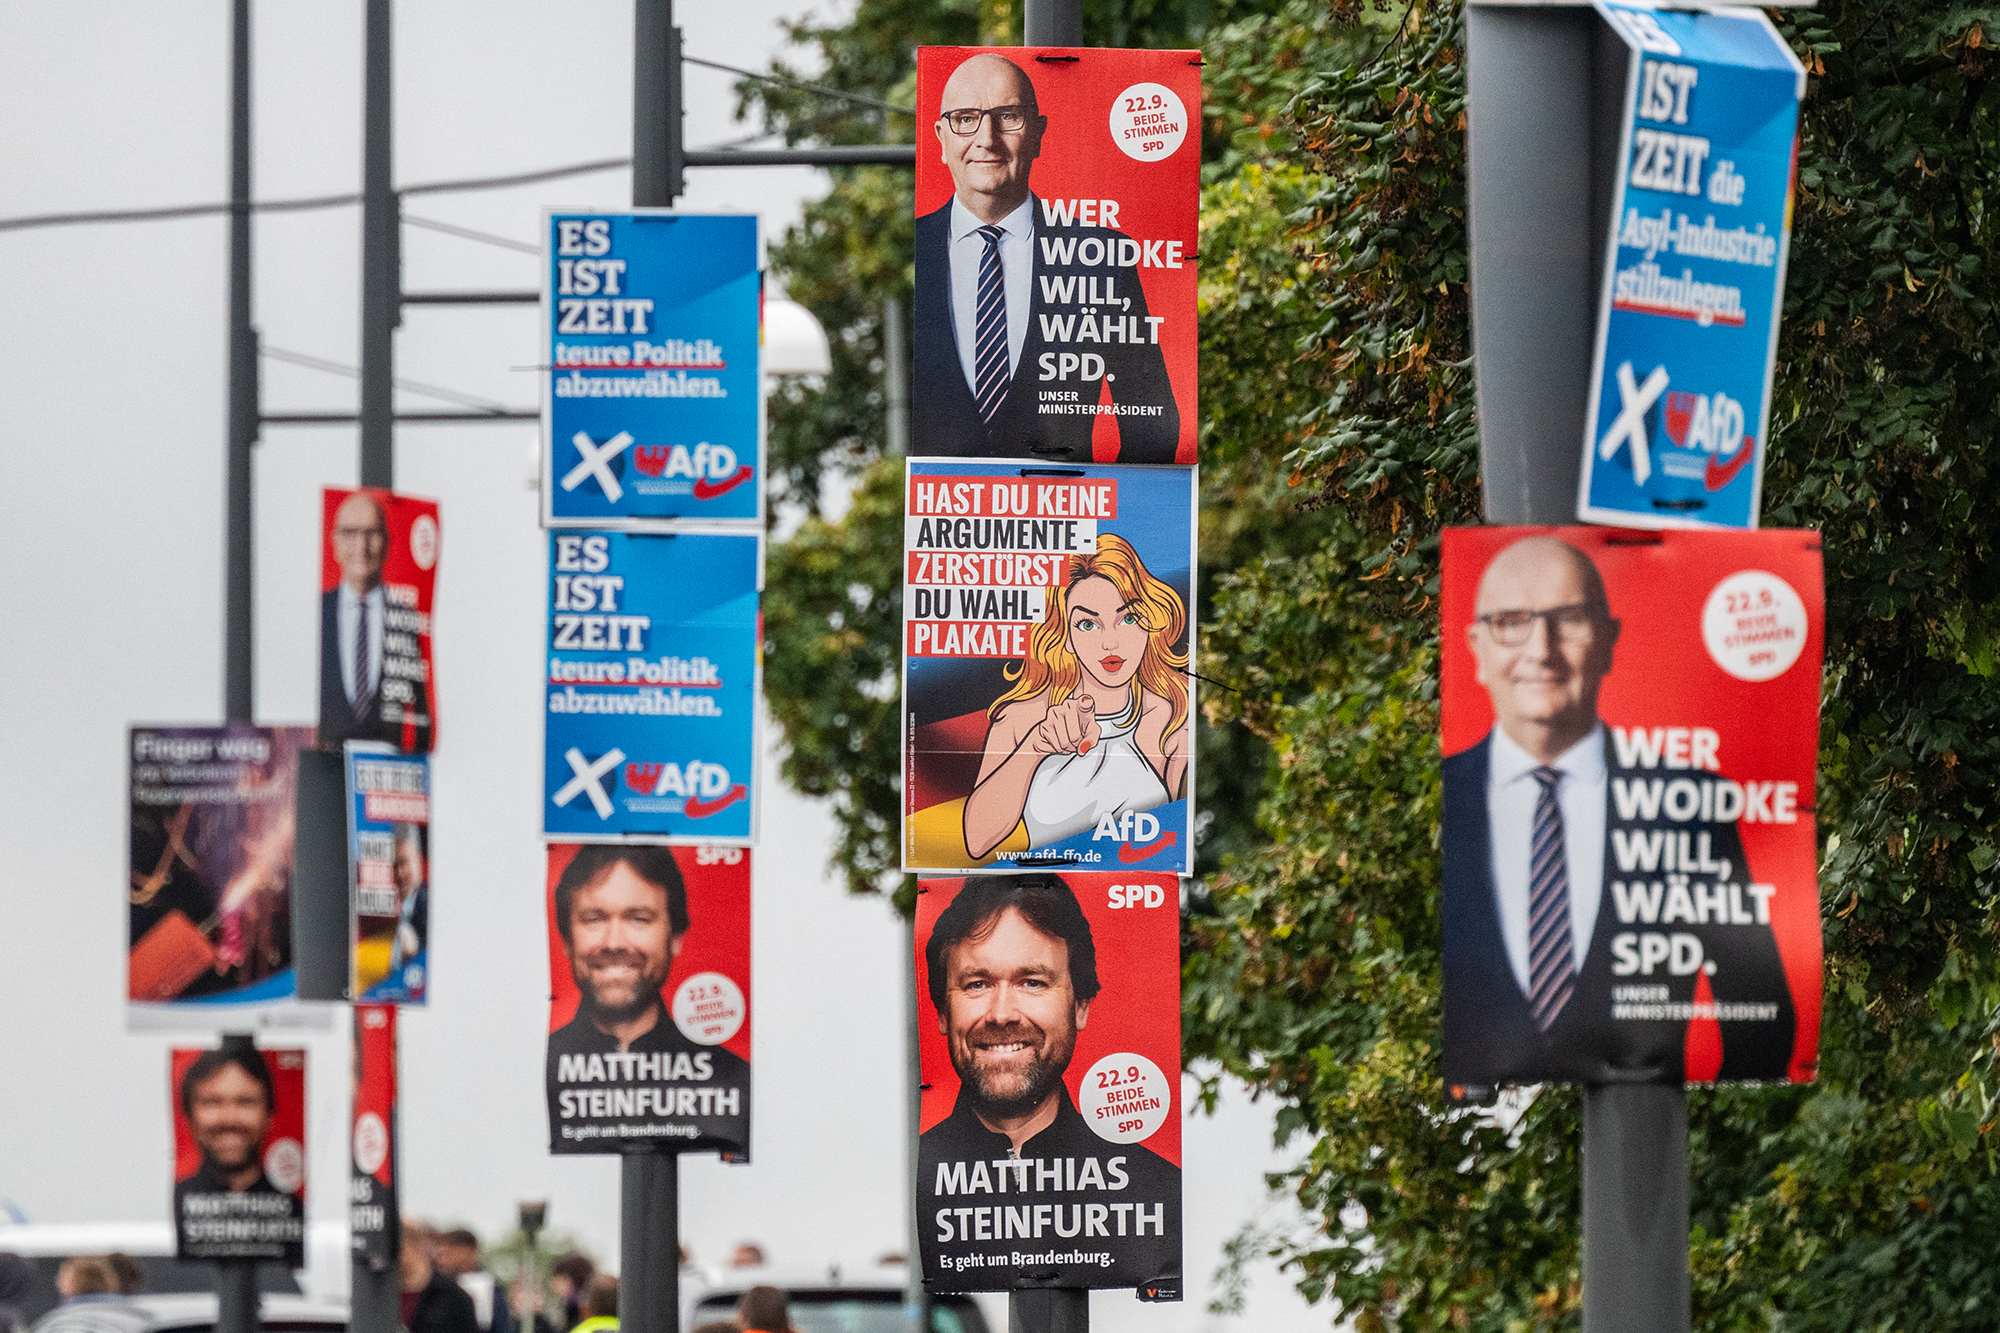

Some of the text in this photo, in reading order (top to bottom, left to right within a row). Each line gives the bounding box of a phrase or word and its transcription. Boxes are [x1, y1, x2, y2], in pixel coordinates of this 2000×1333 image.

[1125, 94, 1168, 113] 22.9.
[1640, 60, 1698, 124] IST
[1124, 122, 1179, 140] STIMMEN
[1133, 112, 1166, 126] BEIDE
[1142, 140, 1164, 152] SPD
[1630, 128, 1746, 206] ZEIT die
[1040, 198, 1121, 229] WER
[557, 219, 610, 256] ES
[1040, 237, 1183, 269] WOIDKE
[1619, 207, 1776, 267] Asyl-Industrie
[557, 259, 626, 295] IST
[1039, 275, 1131, 312] WILL,
[1616, 261, 1746, 326] stillzulegen.
[557, 299, 654, 335] ZEIT
[1038, 307, 1164, 345] WÄHLT
[555, 339, 722, 366] teure Politik
[1038, 352, 1115, 382] SPD.
[555, 370, 727, 398] abzuwählen.
[1038, 391, 1079, 402] UNSER
[1038, 403, 1163, 416] MINISTERPRÄSIDENT
[1687, 391, 1745, 454] AfD
[664, 441, 737, 478] AfD
[916, 482, 1111, 517] HAST DU KEINE
[555, 535, 609, 572] ES
[915, 552, 1064, 587] ZERSTÖRST
[554, 574, 623, 612] IST
[915, 588, 1041, 620] DU WAHL-
[1725, 589, 1781, 614] 22.9.
[553, 614, 650, 651] ZEIT
[914, 623, 1026, 656] PLAKATE
[1724, 627, 1795, 650] STIMMEN
[550, 656, 719, 684] teure Politik
[549, 686, 723, 717] abzuwählen.
[1613, 726, 1721, 771] WER
[655, 760, 730, 798] AfD
[1611, 777, 1799, 824] WOIDKE
[1092, 810, 1160, 842] AfD
[696, 846, 743, 866] SPD
[995, 848, 1102, 863] wwwafd-ffo.de
[1611, 829, 1732, 882] WILL,
[1107, 884, 1165, 910] SPD
[1610, 873, 1776, 926] WÄHLT
[1610, 932, 1718, 977] SPD.
[1611, 984, 1670, 1001] UNSER
[1611, 1001, 1778, 1021] MINISTERPRÄSIDENT
[558, 1052, 714, 1083] MATTHIAS
[1096, 1065, 1147, 1089] 22.9.
[558, 1088, 741, 1119] STEINFURTH
[1095, 1097, 1161, 1120] STIMMEN
[1106, 1087, 1145, 1104] BEIDE
[1118, 1119, 1144, 1134] SPD
[934, 1156, 1129, 1196] MATTHIAS
[935, 1202, 1164, 1243] STEINFURTH
[939, 1249, 1115, 1272] Es geht um Brandenburg.
